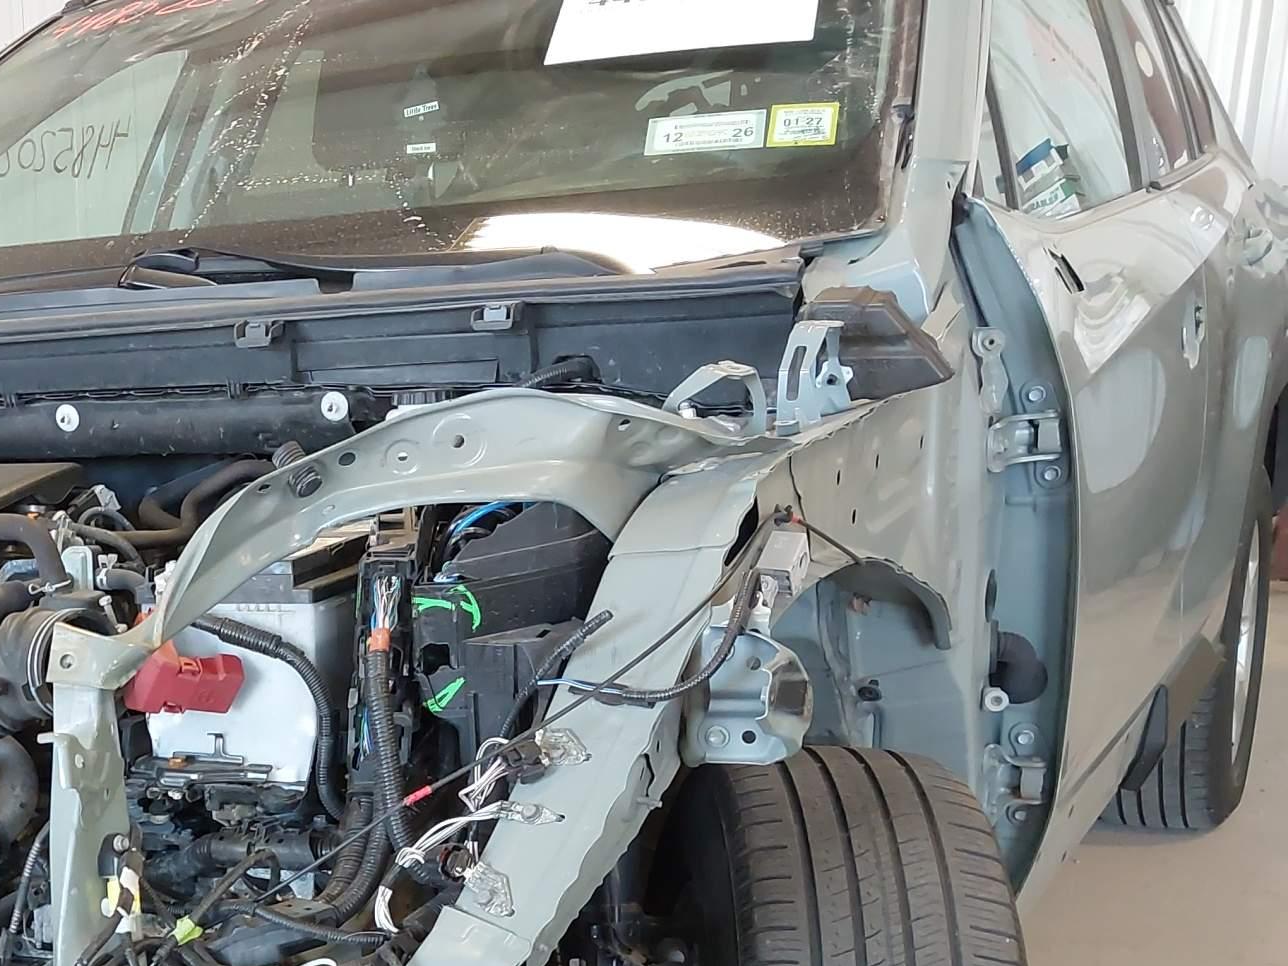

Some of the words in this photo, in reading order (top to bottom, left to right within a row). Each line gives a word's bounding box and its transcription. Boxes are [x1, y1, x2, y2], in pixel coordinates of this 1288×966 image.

[805, 116, 823, 126] 27
[663, 131, 684, 144] 12
[732, 126, 754, 138] 26
